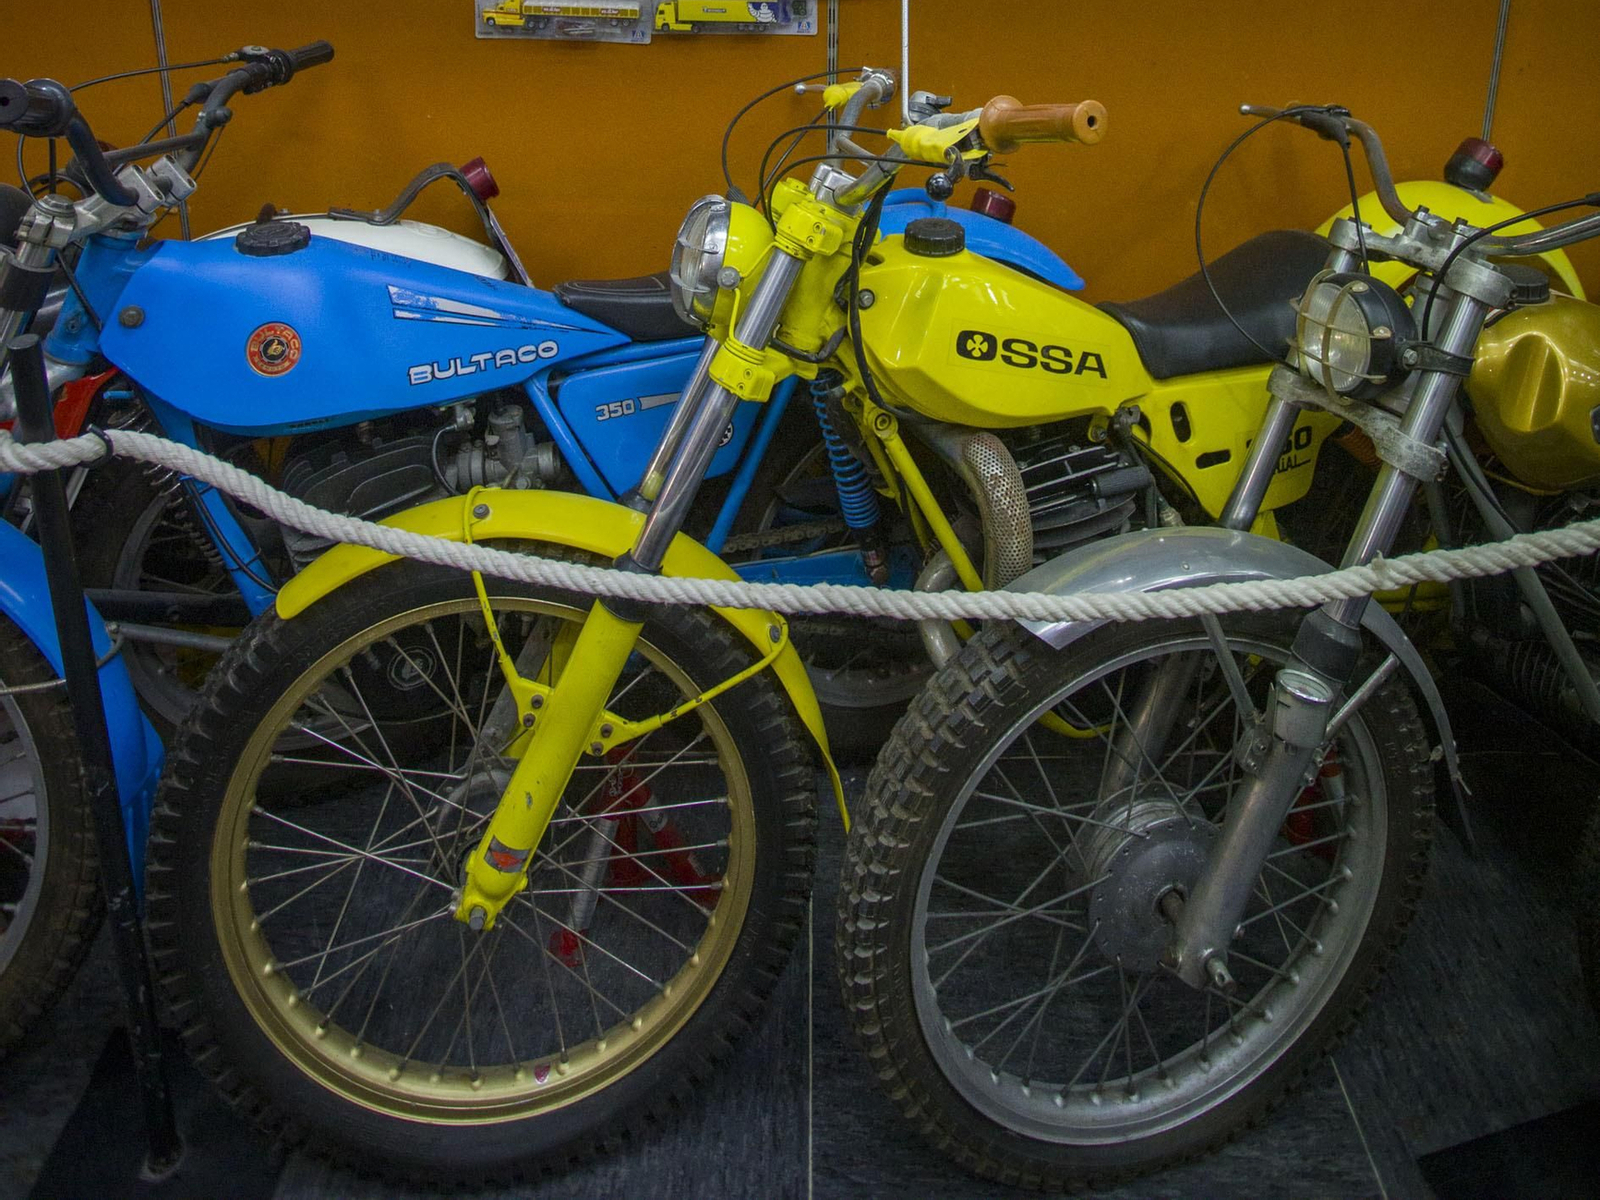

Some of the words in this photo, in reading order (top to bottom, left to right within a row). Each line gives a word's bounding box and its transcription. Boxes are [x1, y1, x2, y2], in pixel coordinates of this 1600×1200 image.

[250, 325, 299, 360] BULTACO
[956, 329, 1108, 380] OSSA
[407, 340, 560, 386] BULTACO
[595, 398, 636, 421] 350
